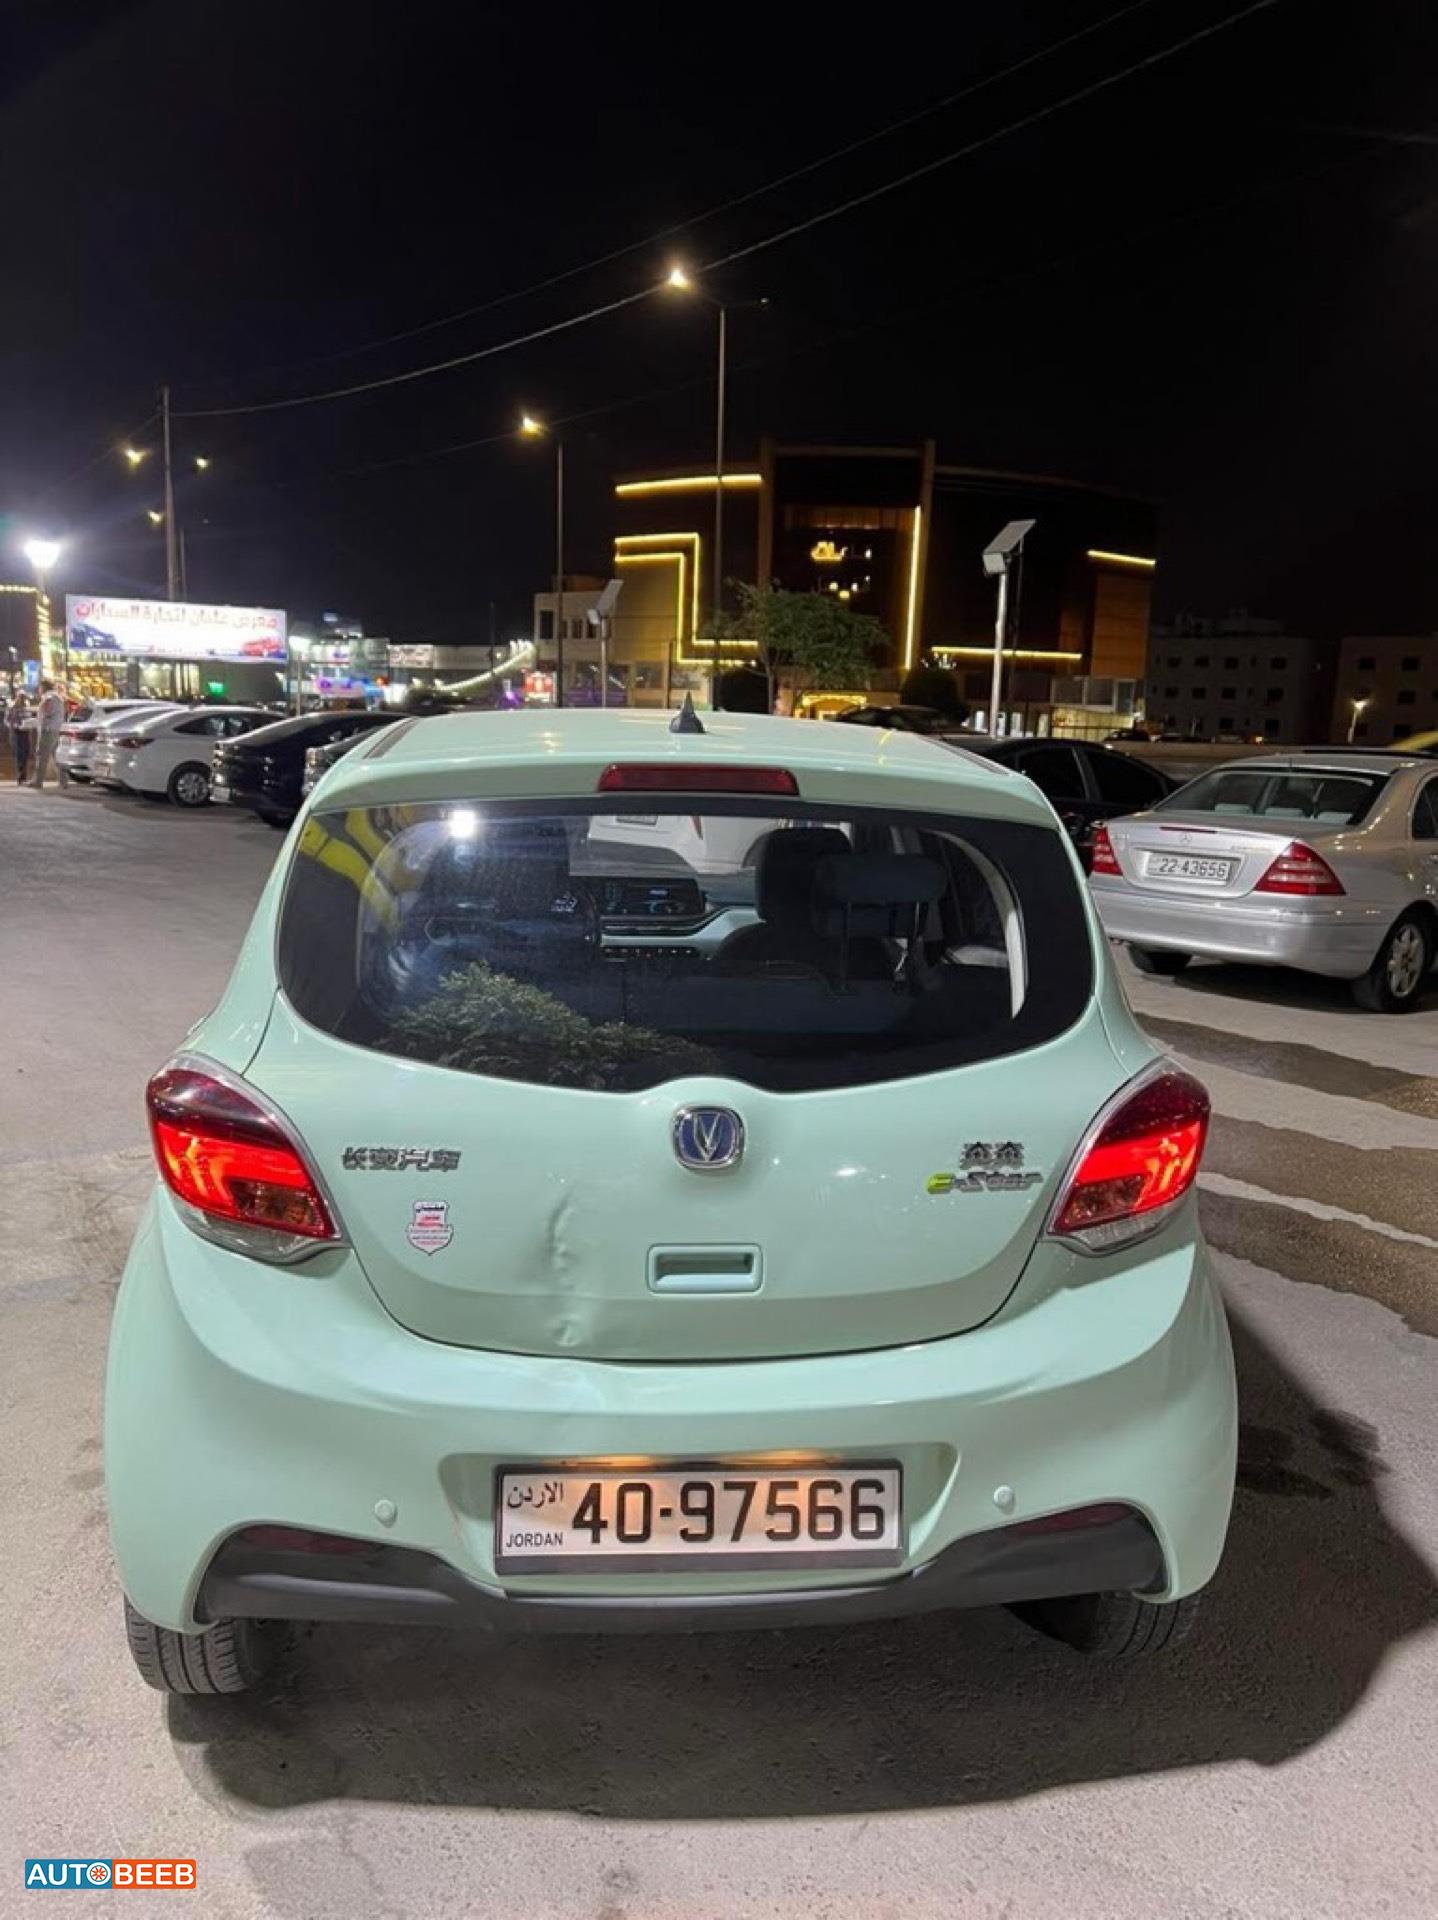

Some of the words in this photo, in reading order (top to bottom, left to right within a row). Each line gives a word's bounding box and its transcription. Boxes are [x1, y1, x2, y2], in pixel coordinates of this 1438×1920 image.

[1159, 857, 1227, 878] 22-43656
[571, 1479, 885, 1544] 40-97566
[506, 1532, 563, 1548] JORDAN
